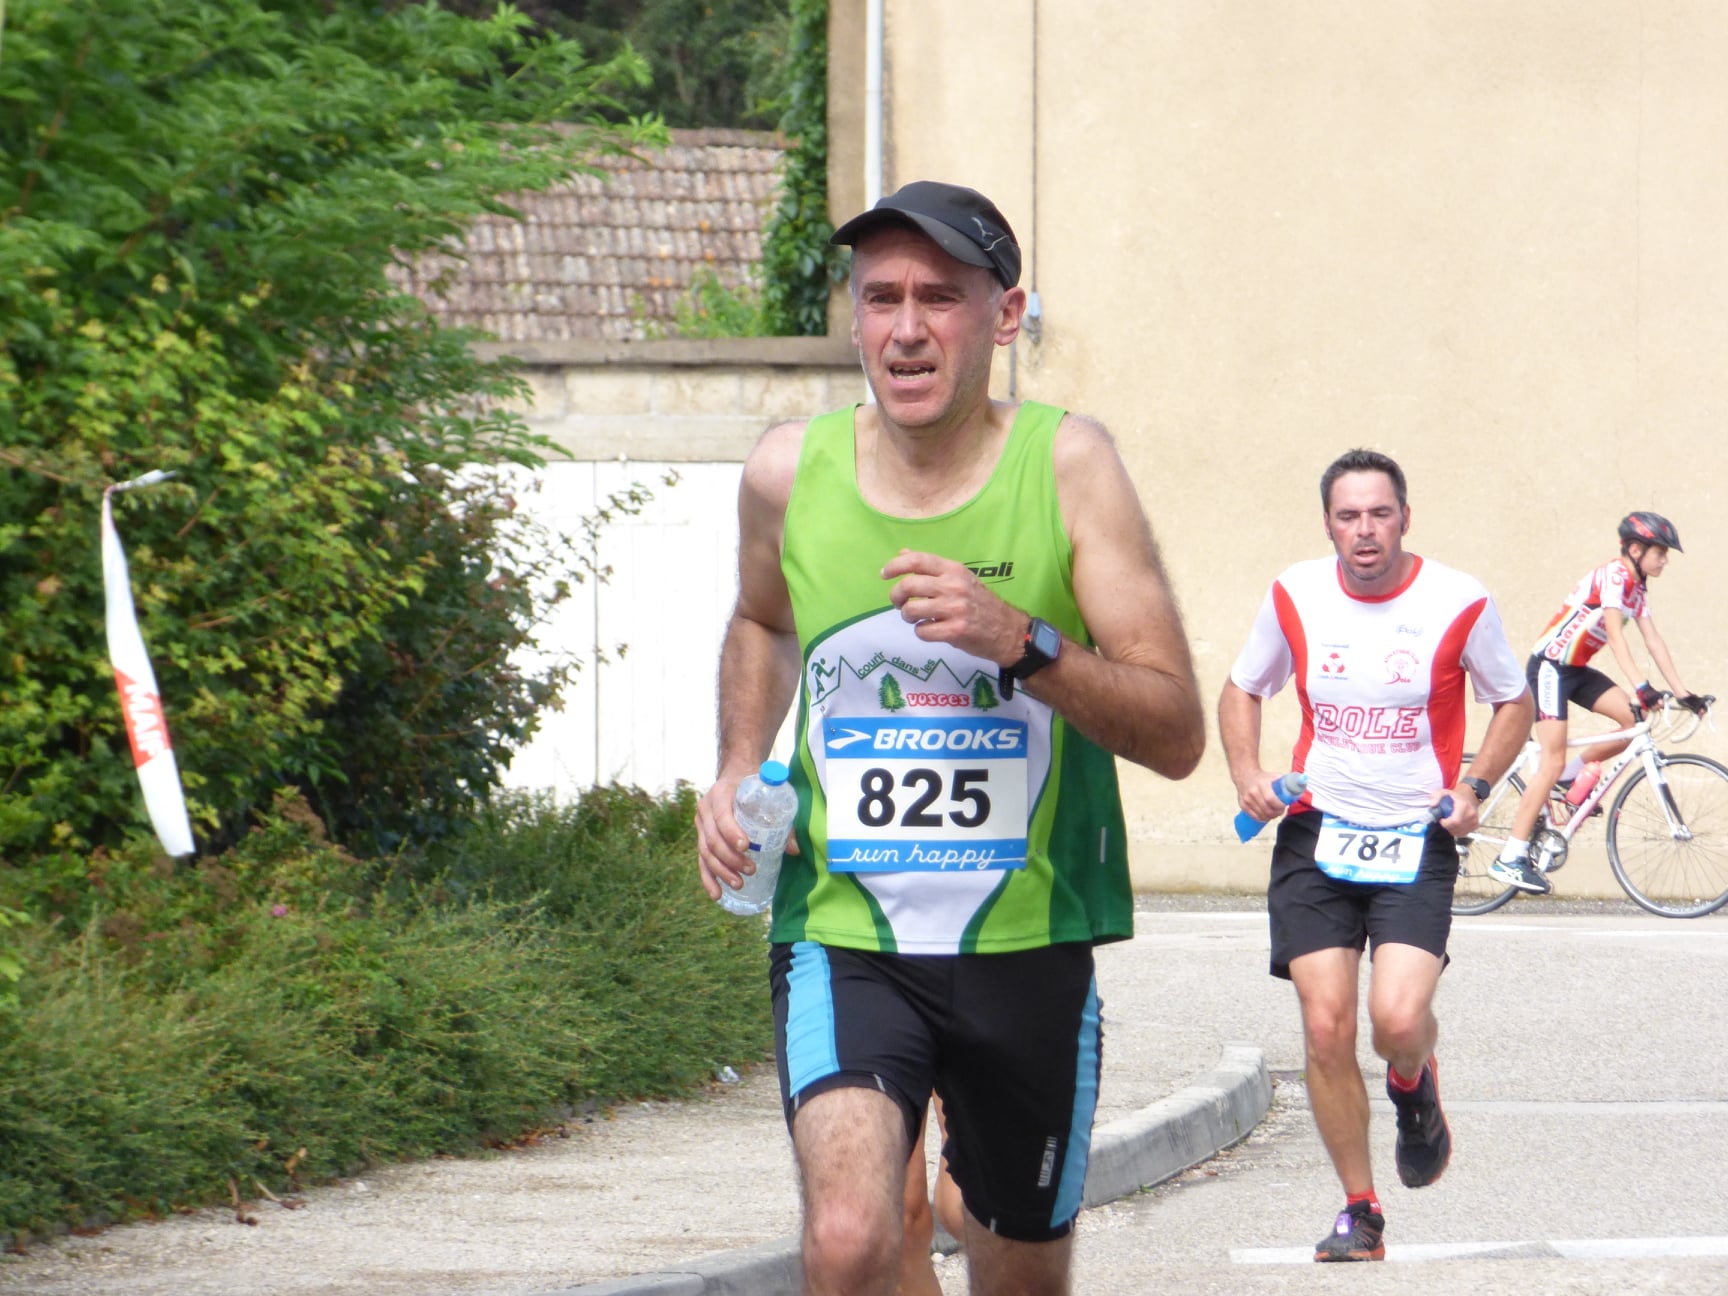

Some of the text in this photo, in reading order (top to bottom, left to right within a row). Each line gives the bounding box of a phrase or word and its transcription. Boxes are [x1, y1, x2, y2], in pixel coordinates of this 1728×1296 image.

[858, 651, 937, 676] courir dans les
[124, 684, 162, 757] MAIF
[1315, 702, 1424, 740] DOLE
[873, 728, 1019, 750] BROOKS
[1390, 741, 1422, 754] CLUB
[857, 767, 991, 828] 825
[848, 841, 996, 870] run happy
[1338, 832, 1402, 864] 784
